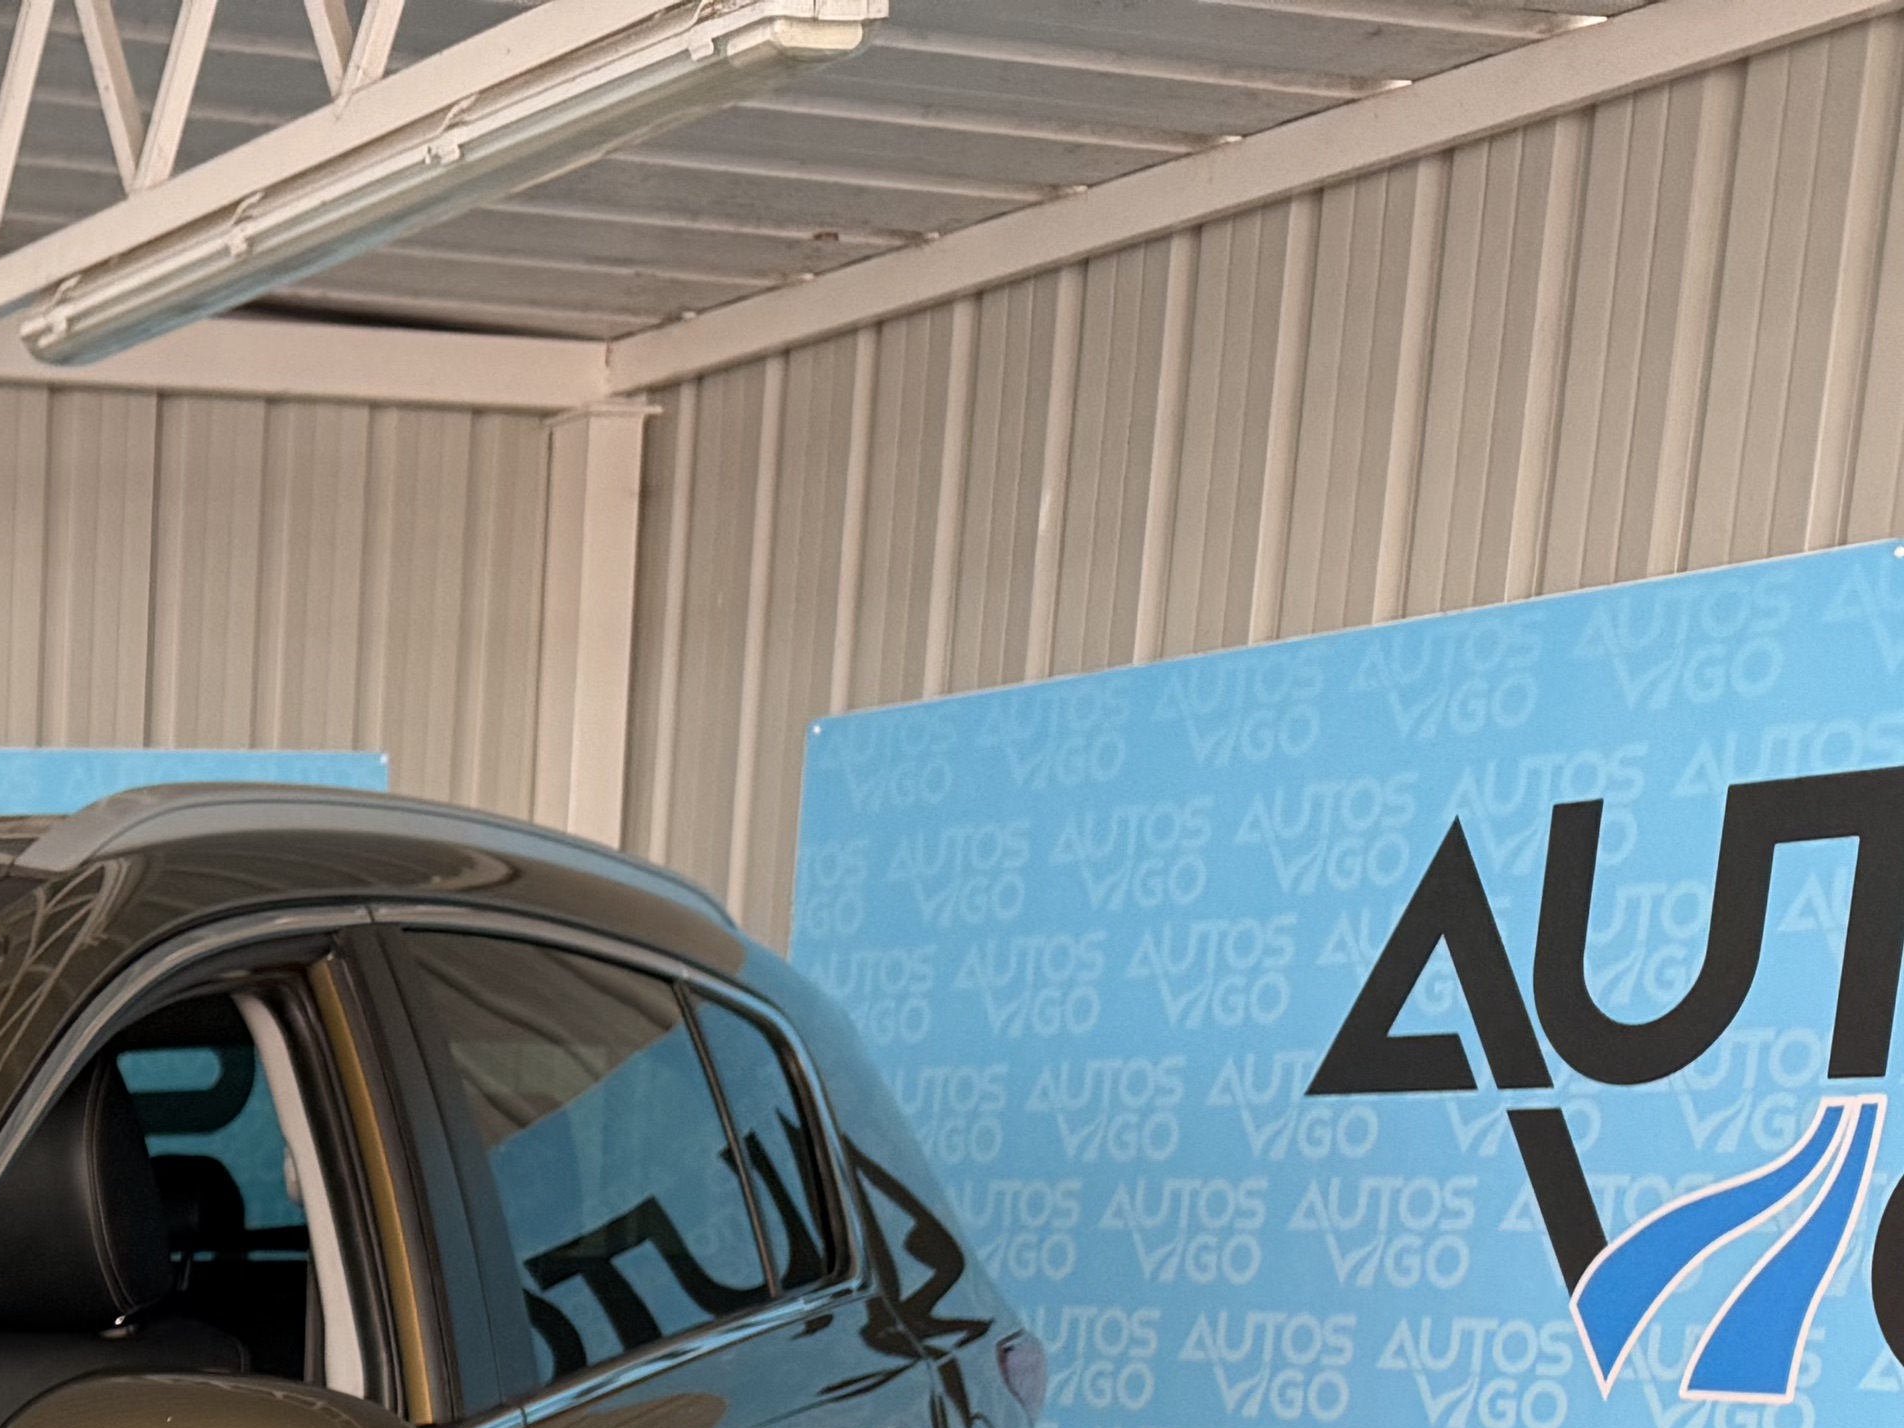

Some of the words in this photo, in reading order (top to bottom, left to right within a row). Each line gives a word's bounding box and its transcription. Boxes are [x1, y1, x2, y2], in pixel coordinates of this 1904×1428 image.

[1574, 571, 1794, 657] AUTOS
[1349, 613, 1545, 693] AUTOS
[1611, 637, 1785, 710] VIGO
[1153, 653, 1325, 721] AUTOS
[1050, 799, 1214, 865] AUTOS
[1235, 771, 1418, 845] AUTOS
[1265, 830, 1409, 895] VIGO
[952, 931, 1106, 990] AUTOS
[1125, 914, 1297, 980] AUTOS
[1305, 765, 1904, 1096] AUT
[1158, 971, 1290, 1029] VIGO
[1025, 1055, 1187, 1112] AUTOS
[1057, 1108, 1180, 1163] VIGO
[1240, 1102, 1378, 1160] VIGO
[1099, 1176, 1269, 1231] AUTOS
[1289, 1174, 1479, 1231] AUTOS
[1130, 1231, 1262, 1284] VIGO
[1324, 1231, 1470, 1289] VIGO
[1179, 1309, 1357, 1366] AUTOS
[1377, 1314, 1574, 1376] AUTOS
[1213, 1361, 1349, 1421] VIGO
